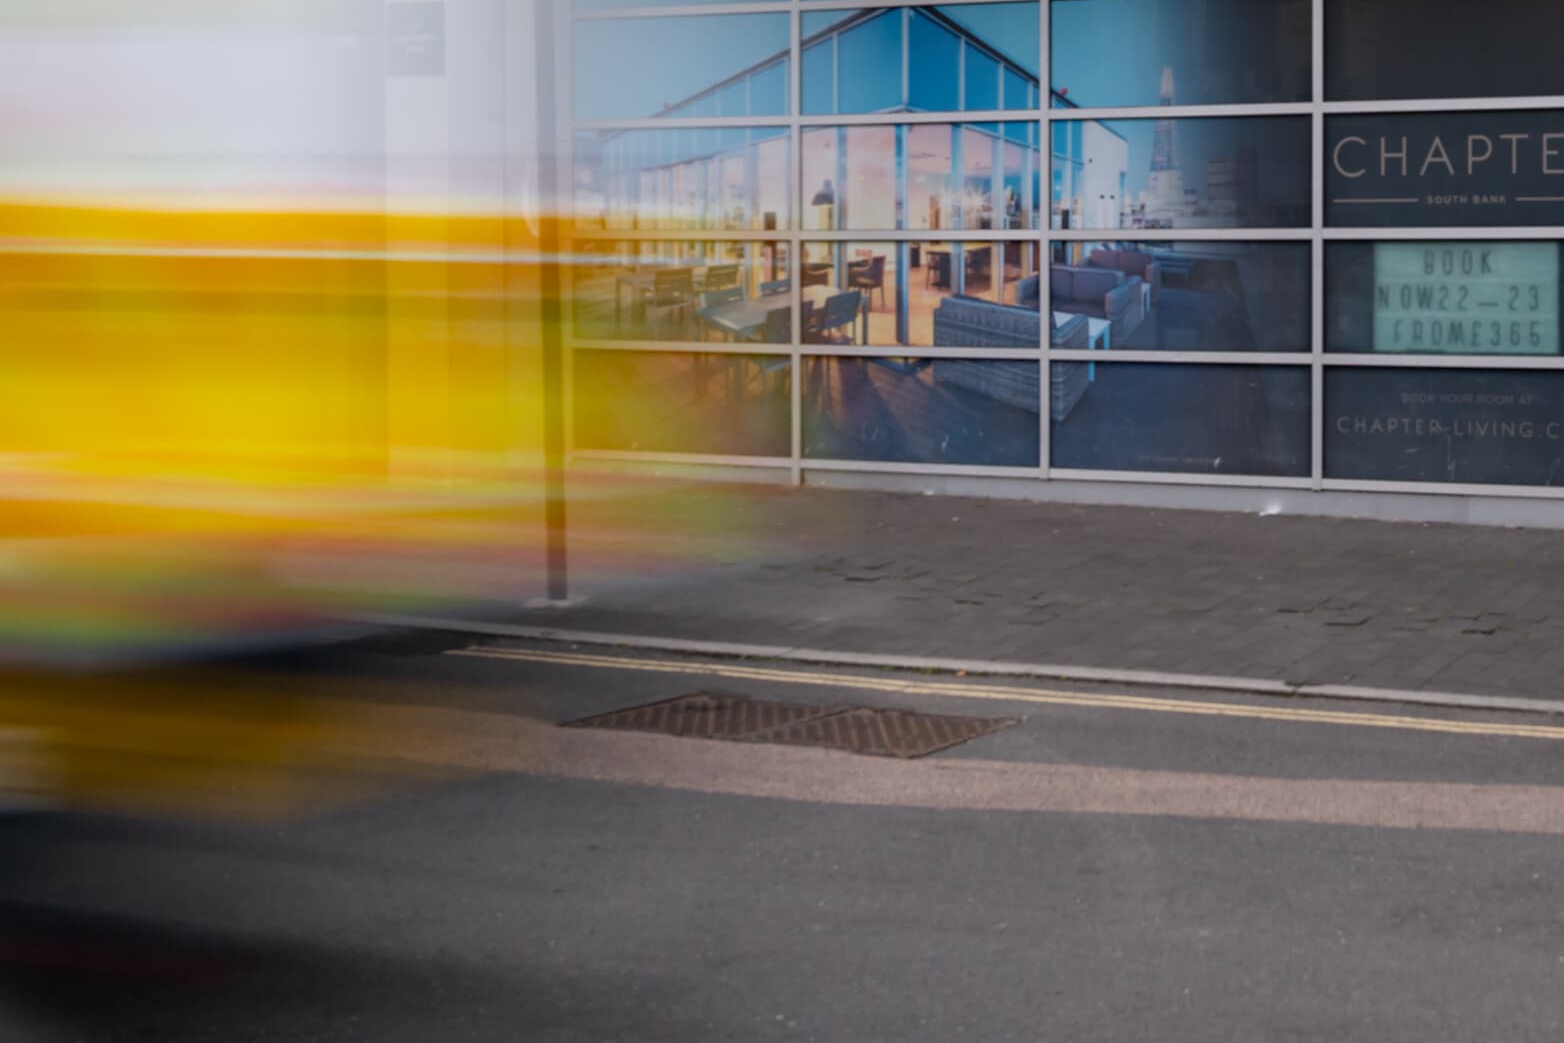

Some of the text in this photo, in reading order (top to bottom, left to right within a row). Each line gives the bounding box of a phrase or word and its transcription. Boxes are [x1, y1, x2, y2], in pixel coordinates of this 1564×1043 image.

[1426, 194, 1507, 206] SOUTH BANK
[1423, 249, 1492, 276] BOOK
